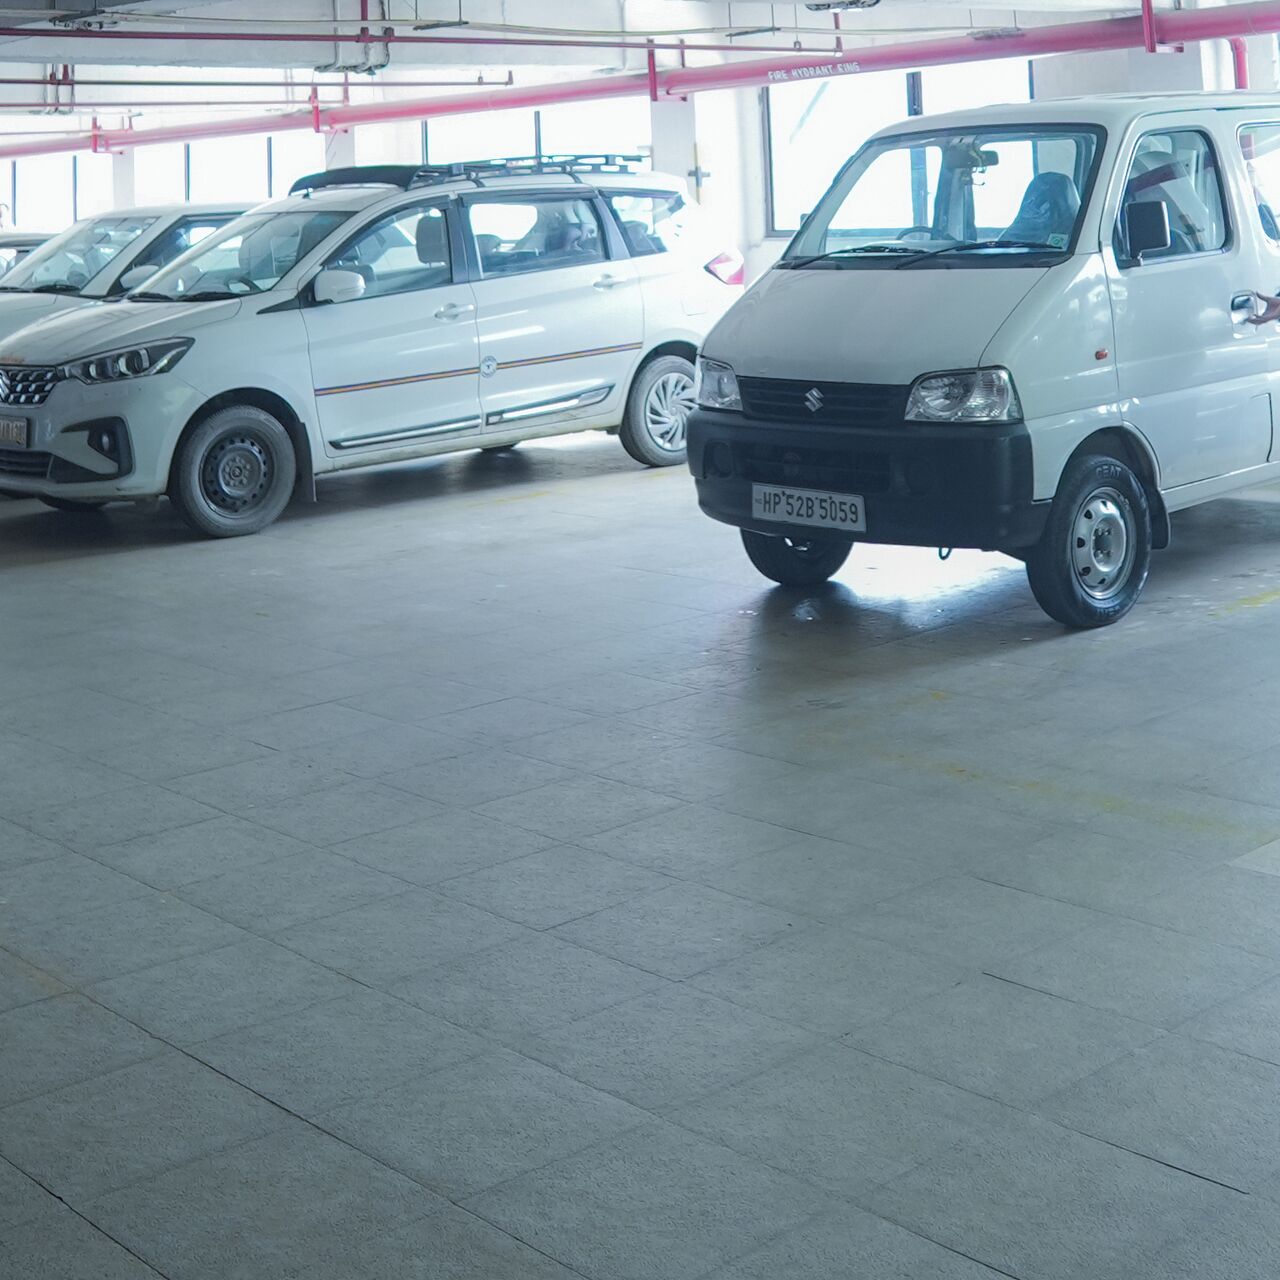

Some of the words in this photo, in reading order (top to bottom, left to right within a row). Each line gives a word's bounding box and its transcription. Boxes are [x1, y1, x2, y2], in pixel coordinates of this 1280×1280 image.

[768, 70, 789, 80] FIRE
[791, 65, 833, 79] HYDRANT
[819, 498, 859, 523] 5059
